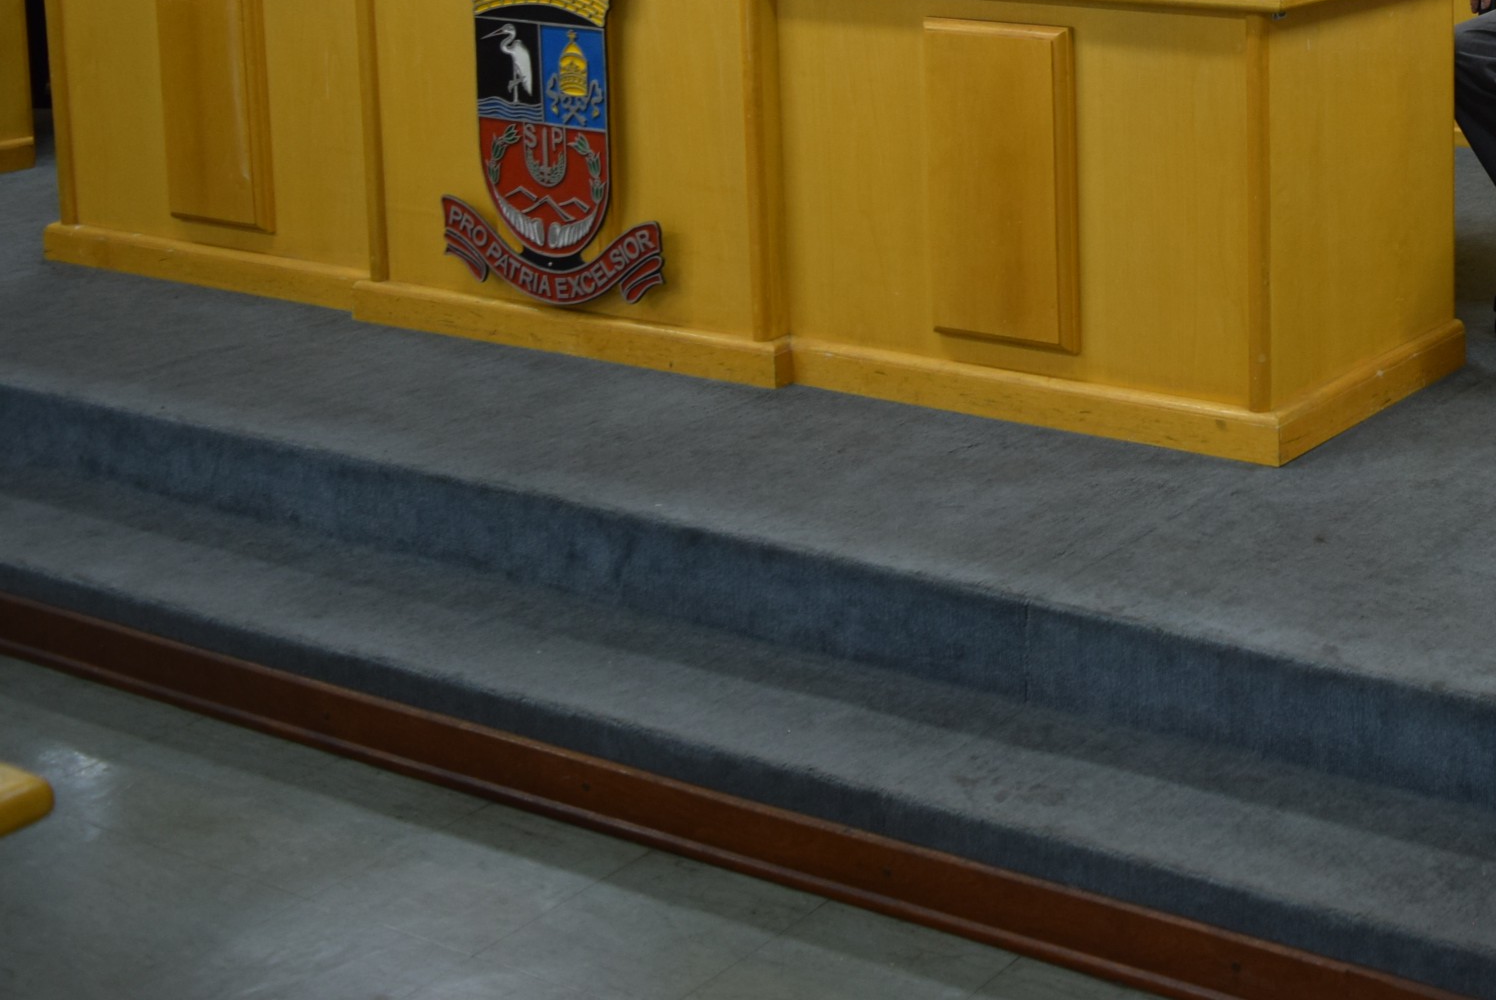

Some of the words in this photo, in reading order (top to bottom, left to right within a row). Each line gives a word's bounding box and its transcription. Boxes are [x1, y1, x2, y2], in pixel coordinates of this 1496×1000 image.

[449, 206, 487, 247] PRO
[486, 244, 551, 297] PATRIA
[554, 230, 655, 299] EXCELSIOR
